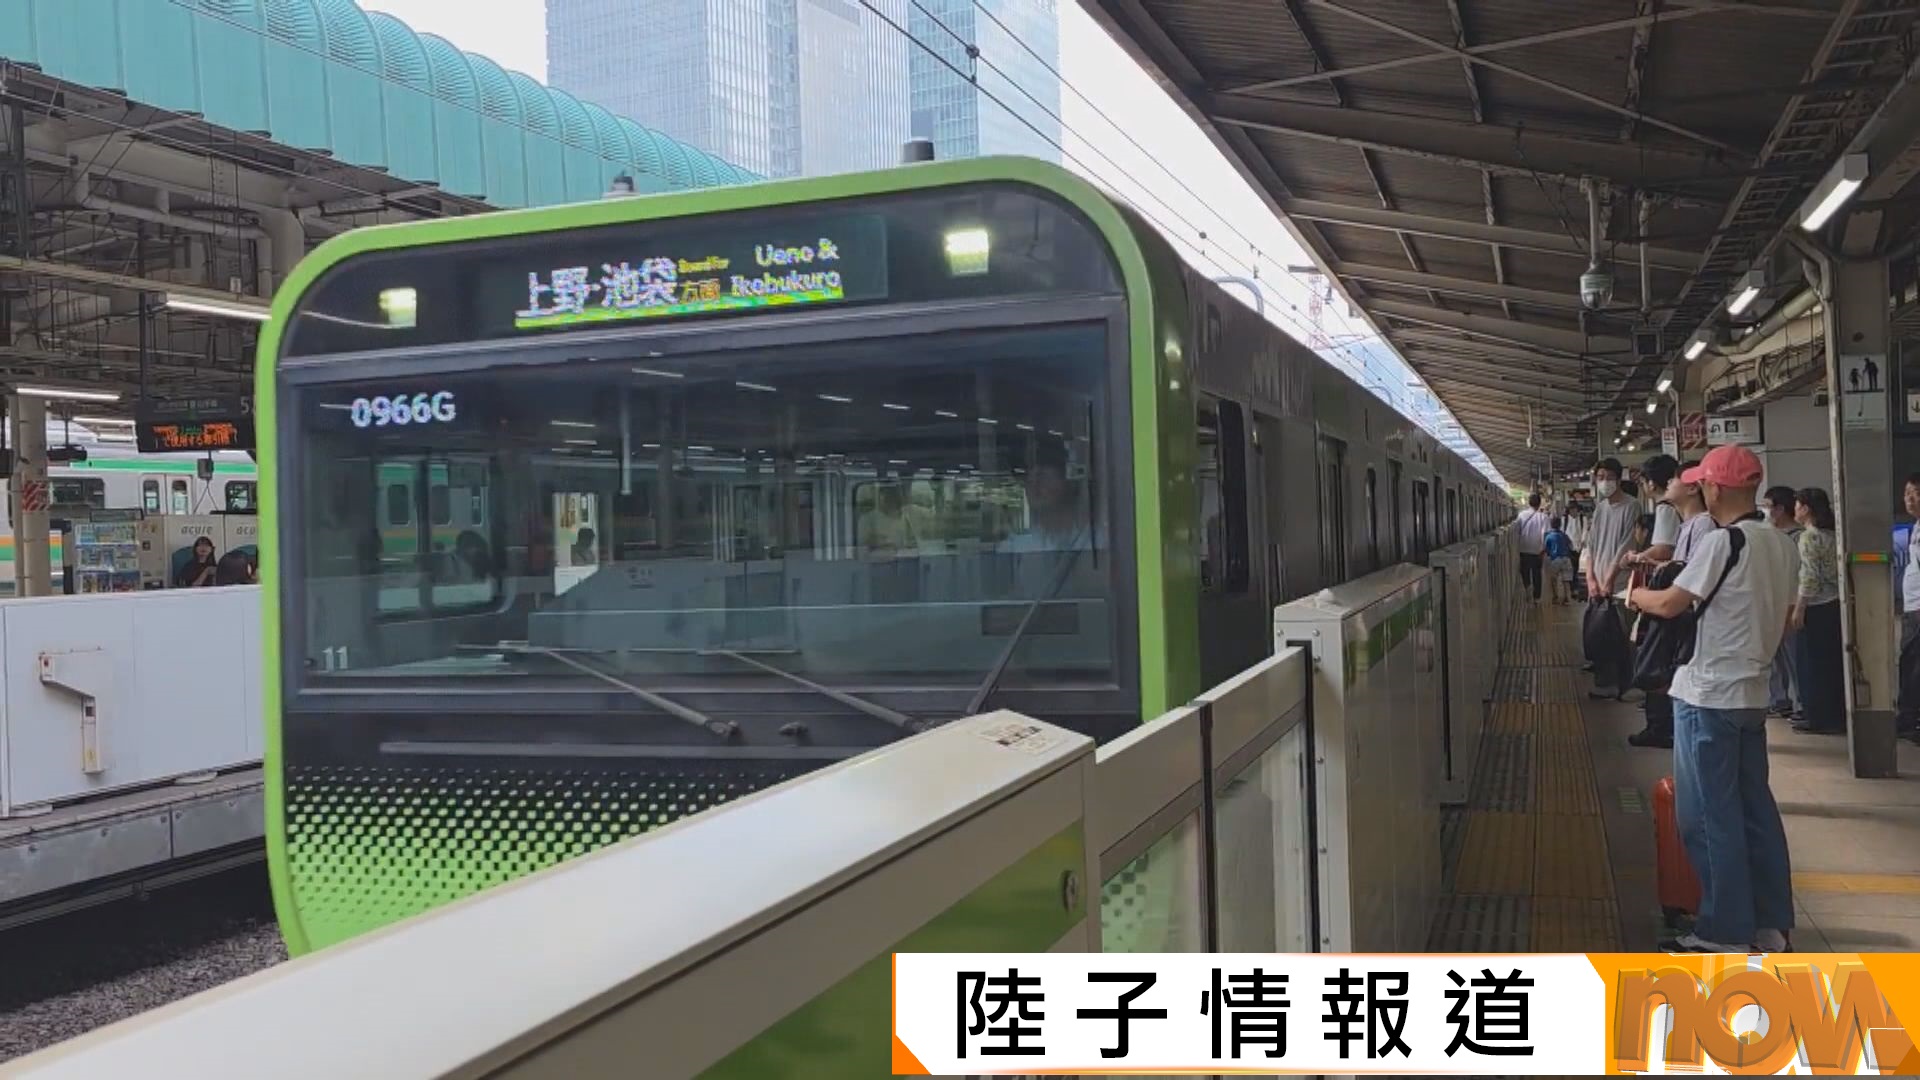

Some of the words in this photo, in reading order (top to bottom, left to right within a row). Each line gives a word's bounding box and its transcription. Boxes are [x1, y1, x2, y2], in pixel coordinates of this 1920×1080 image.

[755, 243, 815, 268] Ueno
[817, 237, 841, 260] &
[351, 390, 457, 428] 0966G
[236, 525, 257, 535] acu
[321, 646, 348, 670] 11
